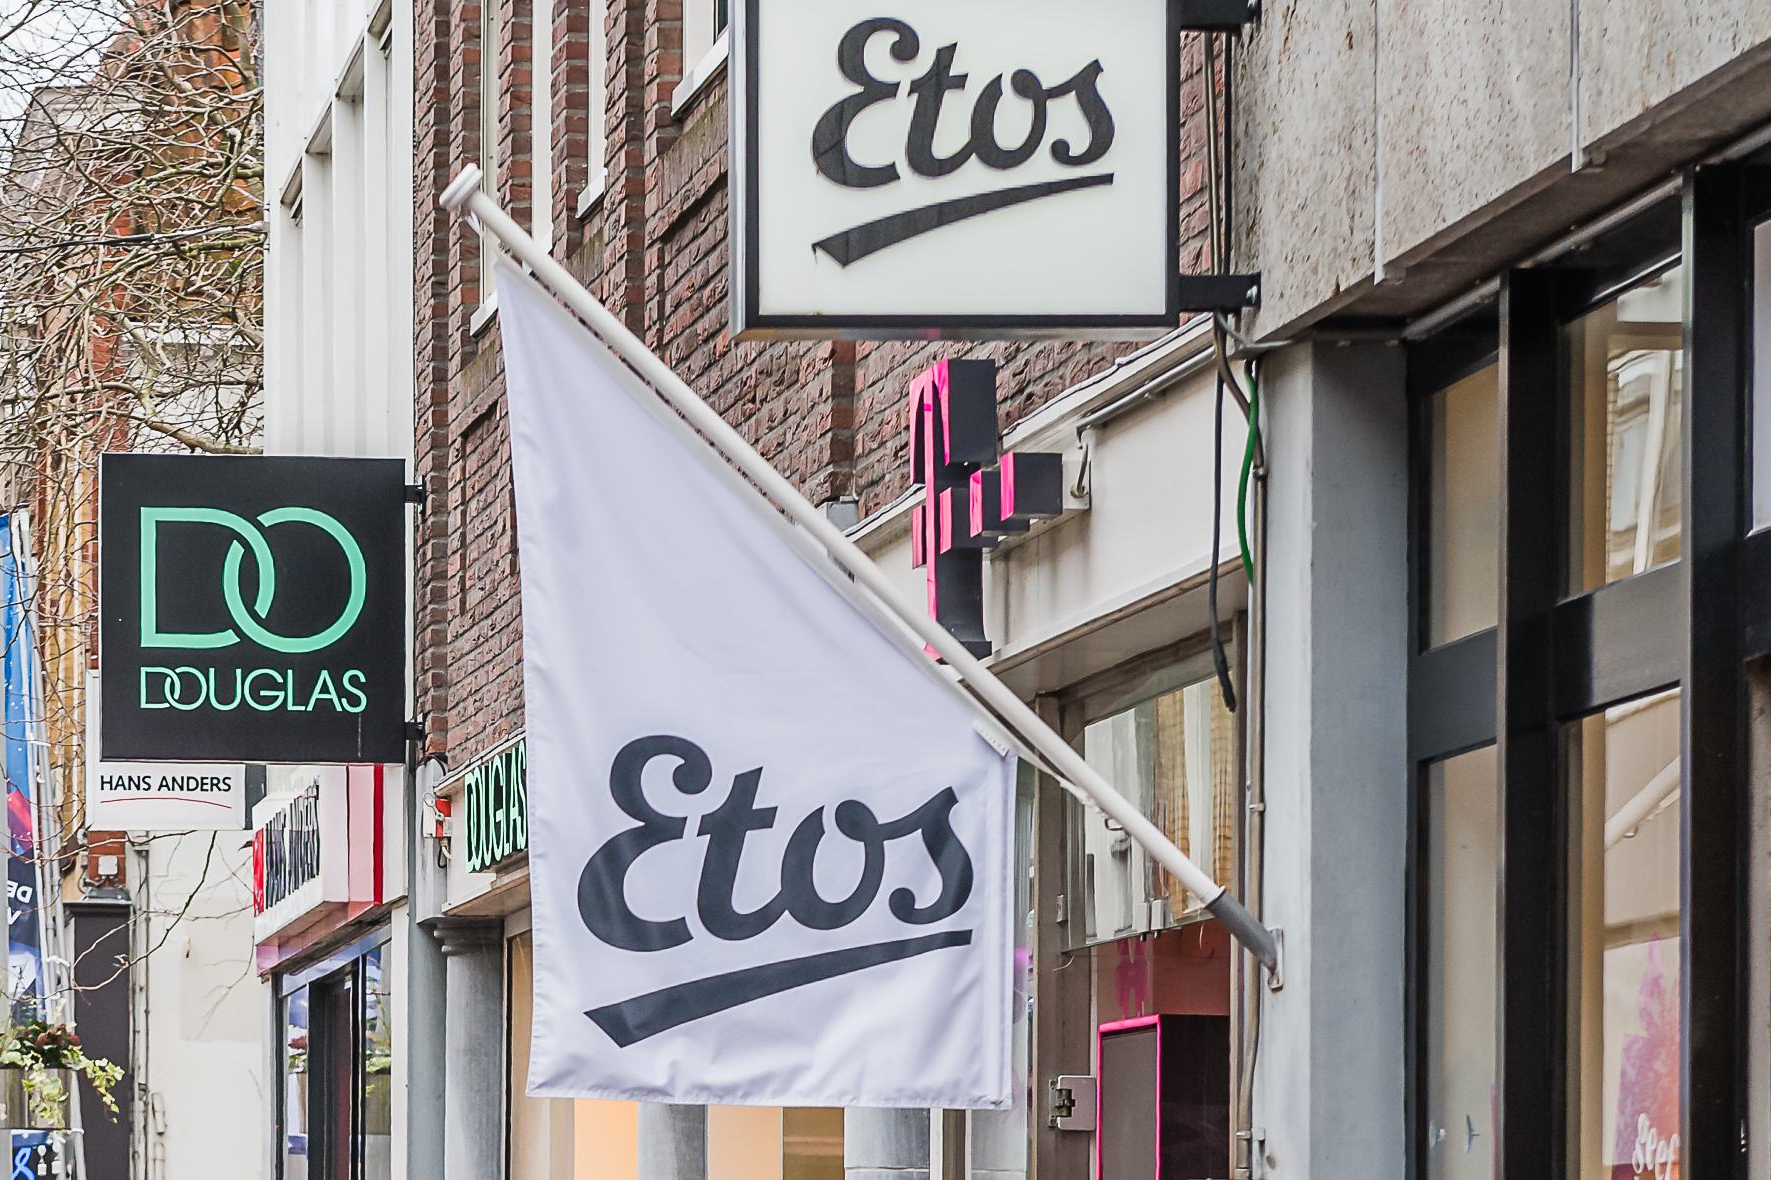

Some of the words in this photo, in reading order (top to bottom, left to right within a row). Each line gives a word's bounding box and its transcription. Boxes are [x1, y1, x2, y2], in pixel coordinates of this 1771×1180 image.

[811, 17, 1116, 189] Etos
[140, 506, 367, 653] DO
[140, 666, 367, 713] DOUGLAS
[100, 775, 152, 792] HANS
[157, 775, 232, 793] ANDERS
[464, 740, 527, 874] DOUGLAS
[577, 734, 974, 952] Etos
